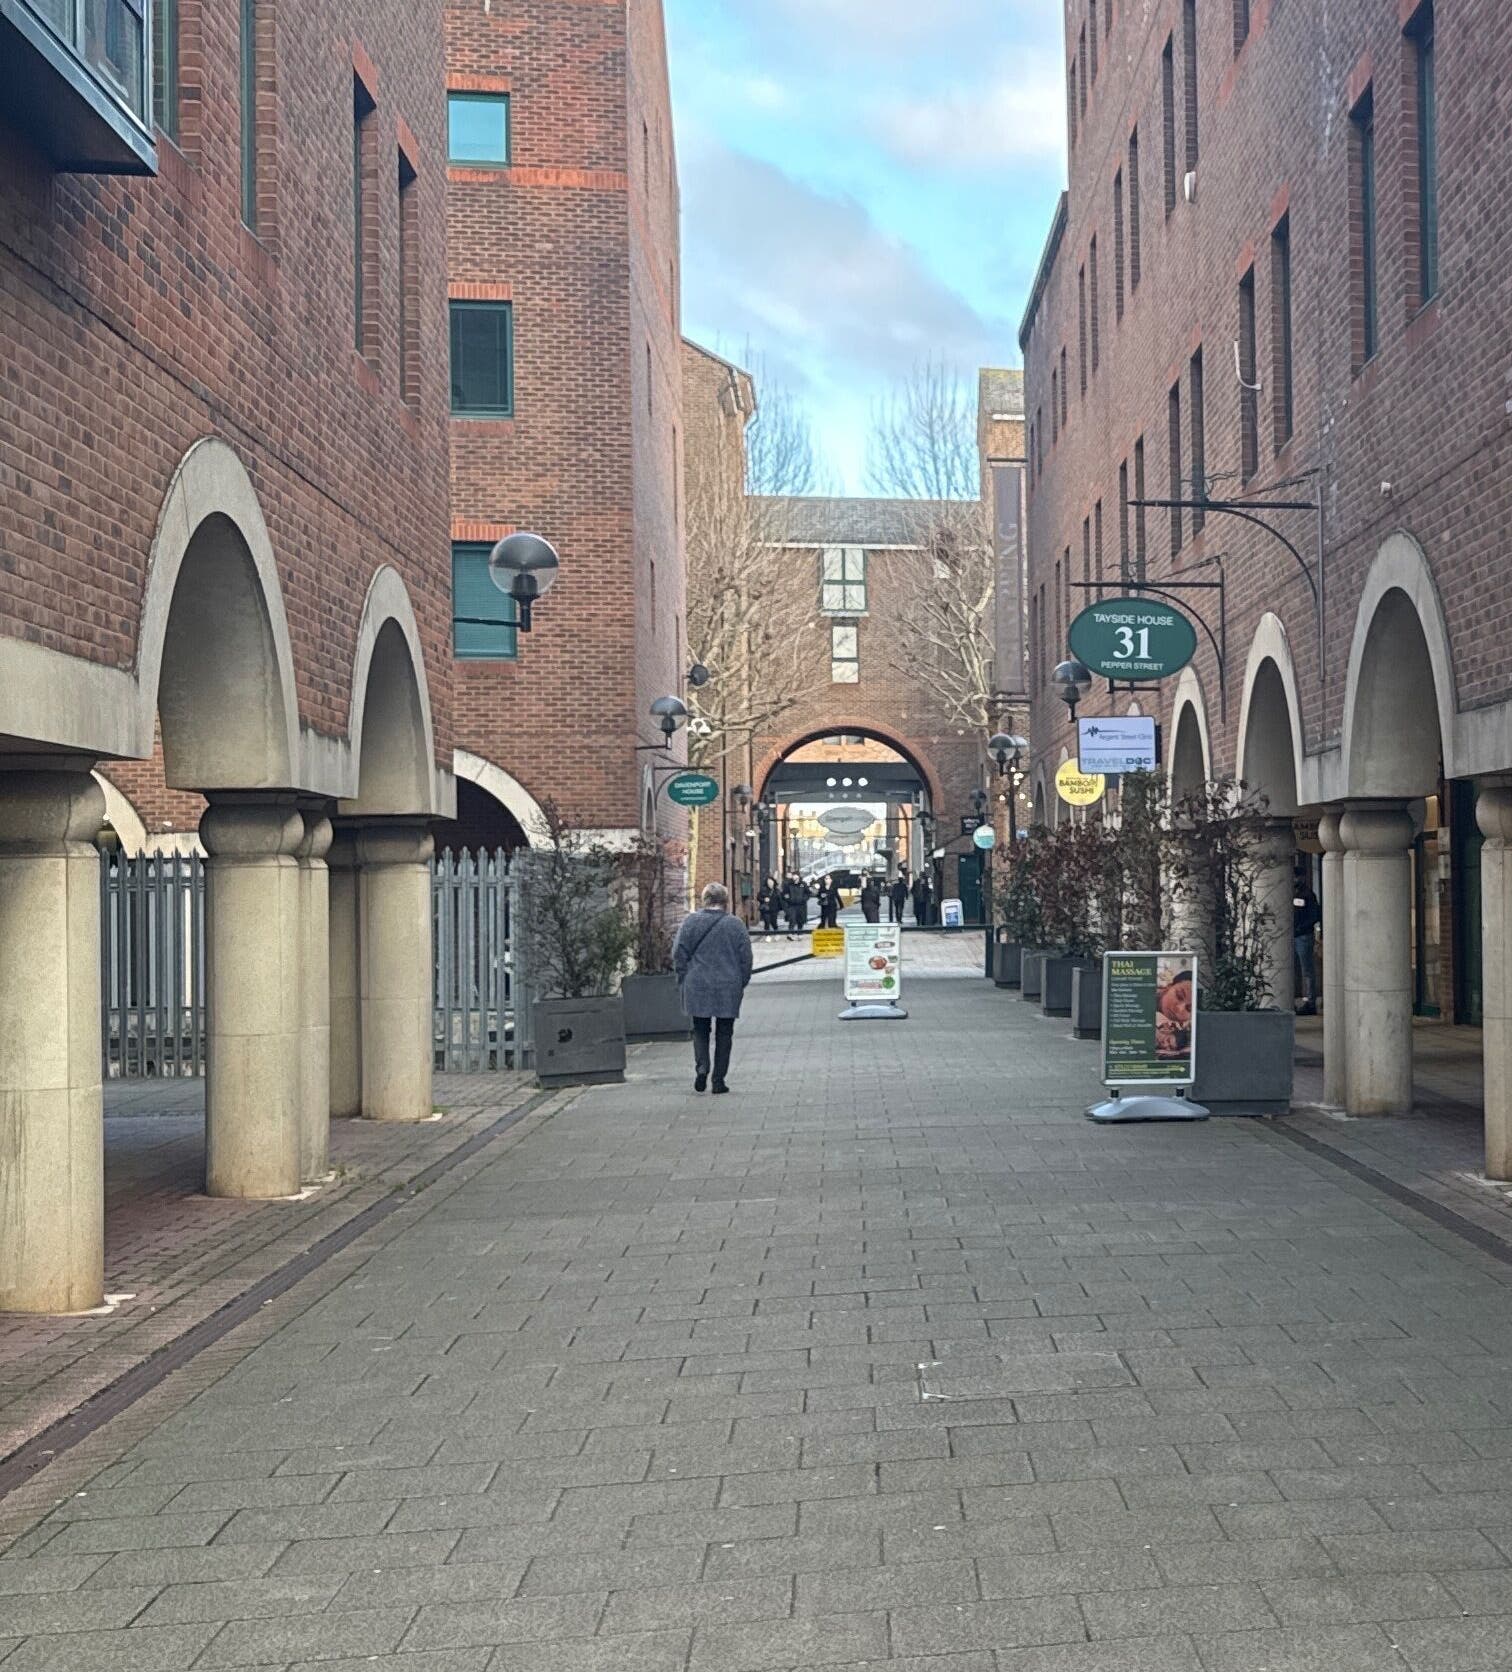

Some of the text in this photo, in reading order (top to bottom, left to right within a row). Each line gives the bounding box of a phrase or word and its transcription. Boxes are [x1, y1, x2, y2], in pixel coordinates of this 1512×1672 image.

[1094, 613, 1175, 626] TAYSIDE HOUSE
[1112, 626, 1153, 660] 31
[1101, 661, 1164, 671] PEPPER STREET
[1111, 960, 1134, 968] THAI
[1111, 968, 1152, 976] MASSAGE
